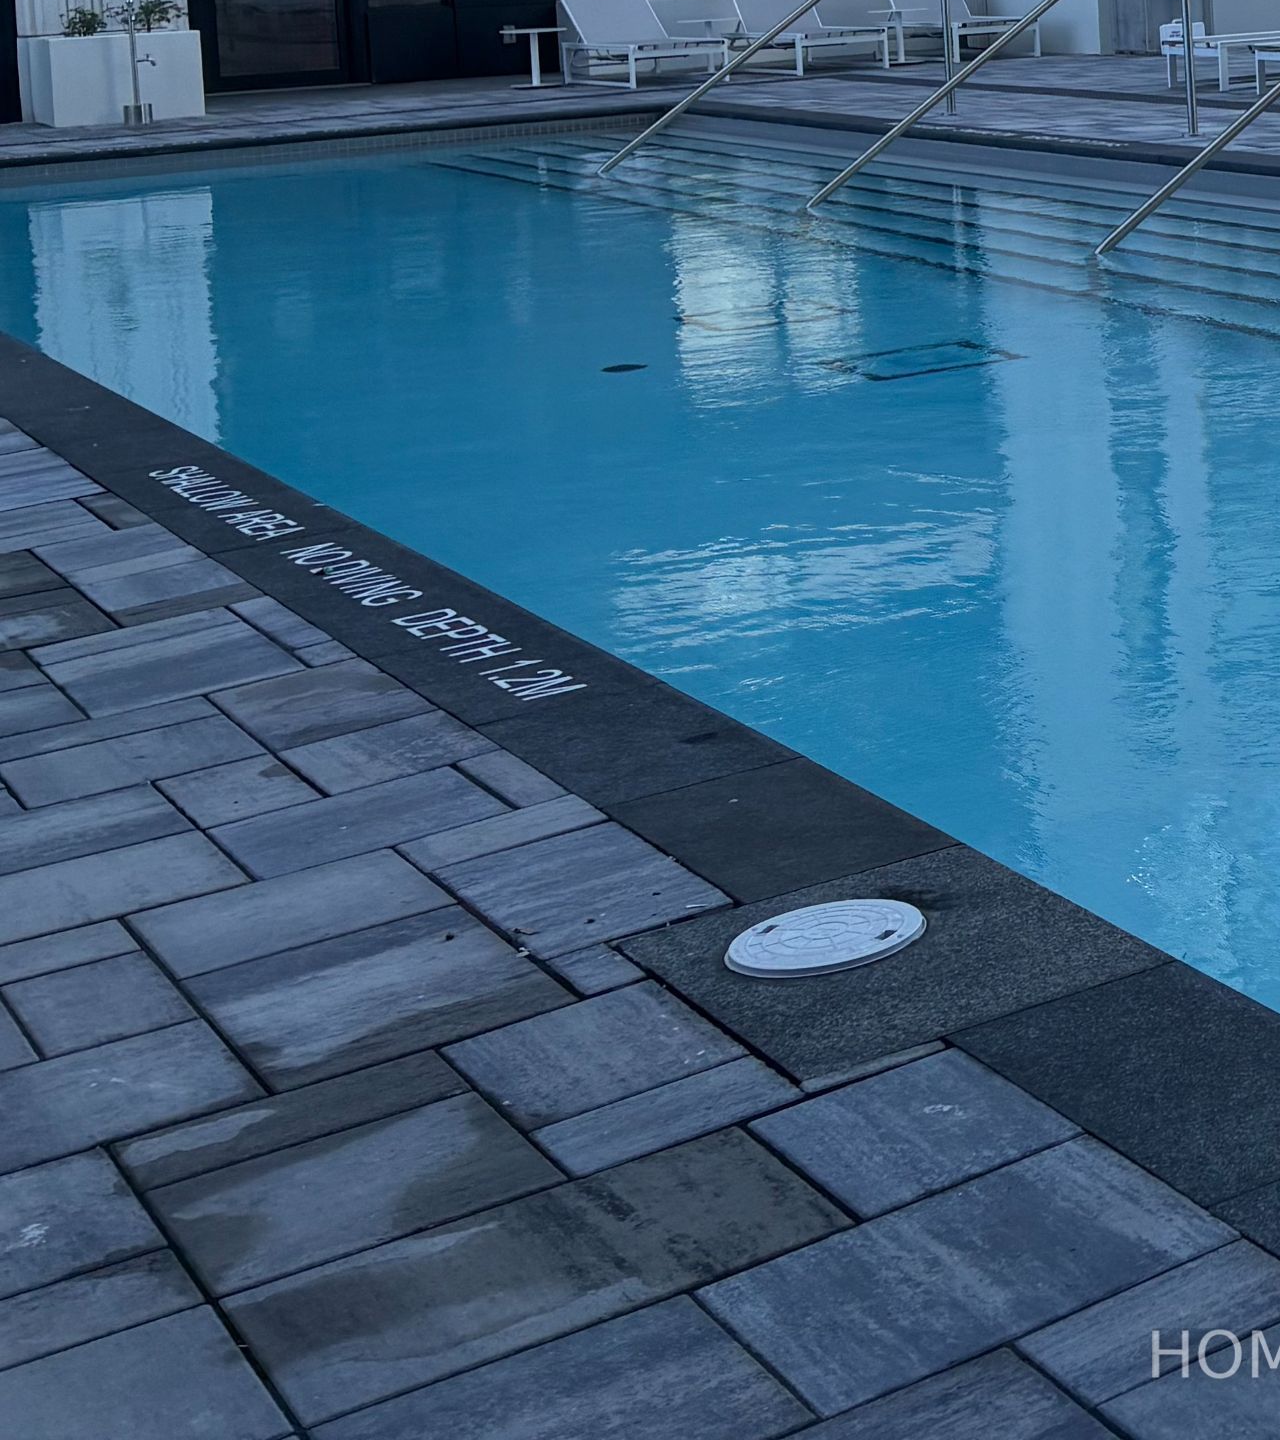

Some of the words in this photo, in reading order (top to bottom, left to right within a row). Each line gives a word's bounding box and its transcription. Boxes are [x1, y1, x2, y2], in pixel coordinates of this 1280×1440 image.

[147, 465, 259, 511] SHALLOW
[217, 508, 305, 541] AREA
[280, 542, 353, 565] NO
[322, 559, 424, 607] DIVING
[391, 608, 522, 663] DEPTH
[478, 659, 588, 701] 1.2M
